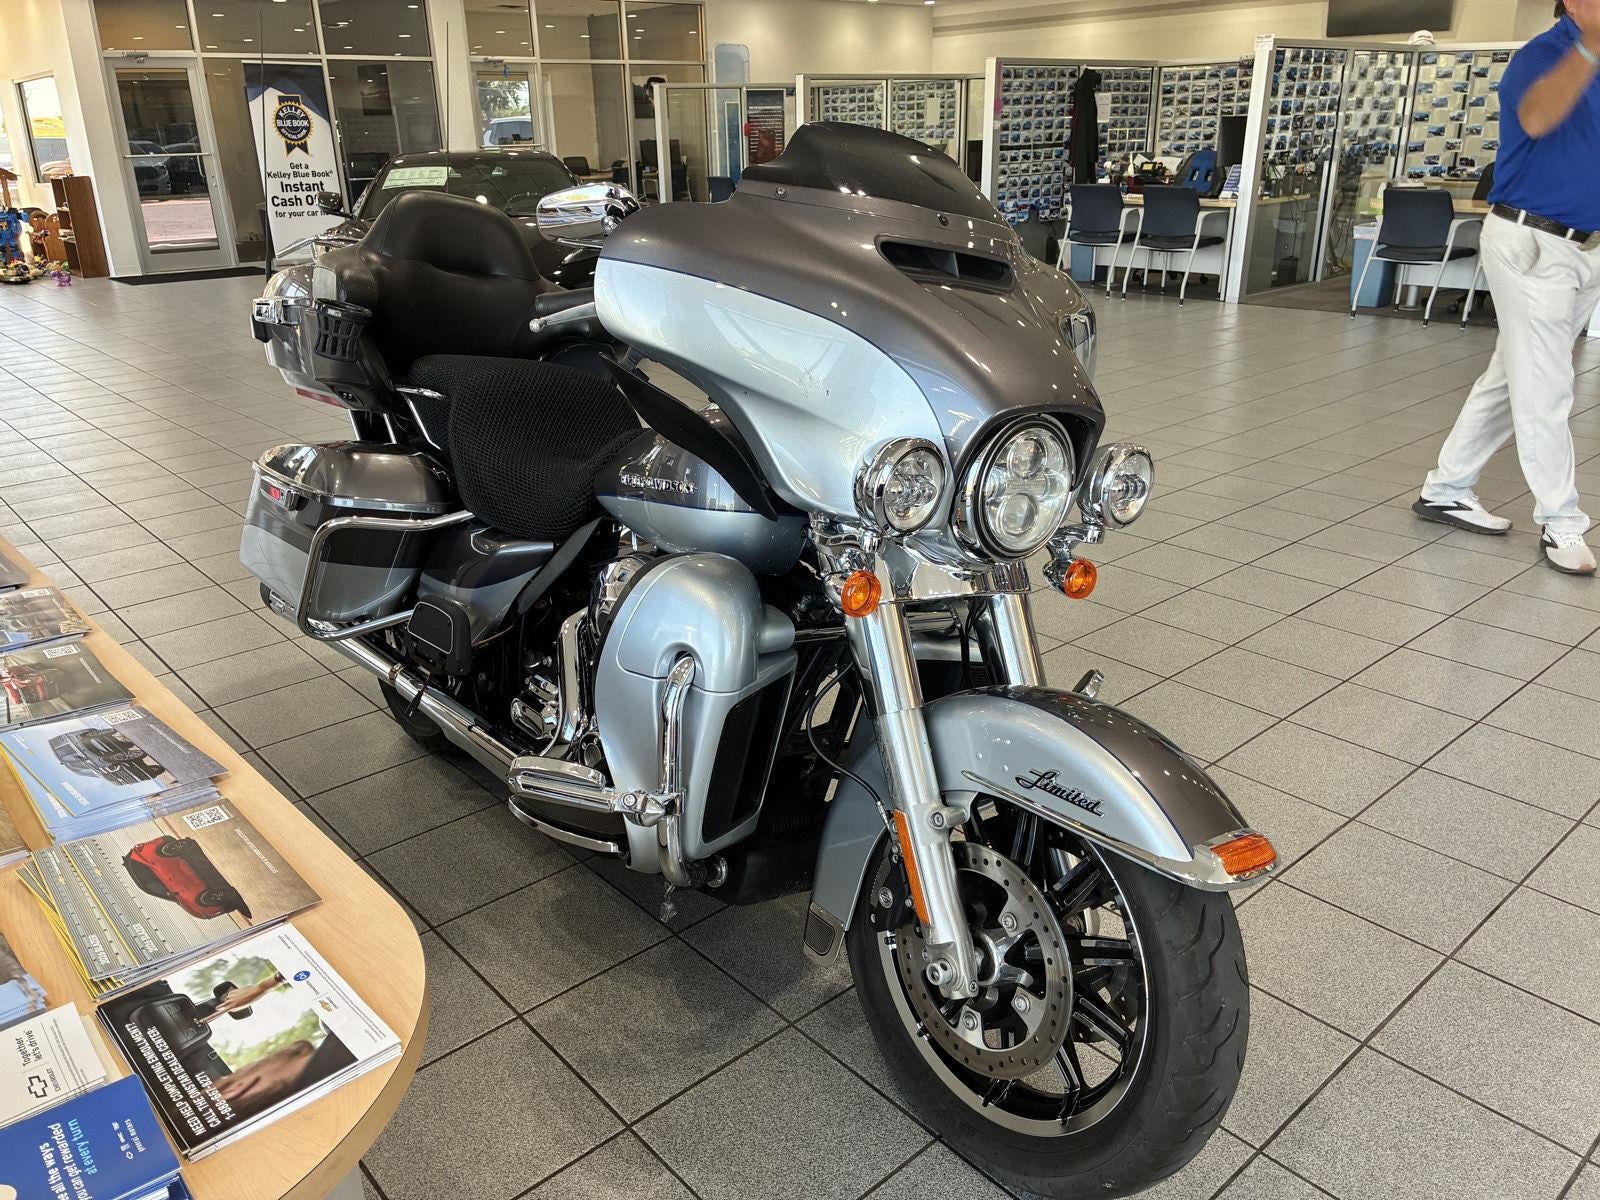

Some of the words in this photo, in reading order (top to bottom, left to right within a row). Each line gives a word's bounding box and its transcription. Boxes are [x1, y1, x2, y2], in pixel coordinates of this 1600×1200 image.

[279, 106, 305, 117] KELLEY
[276, 119, 292, 127] BLUE
[292, 119, 309, 127] BOOK
[267, 171, 291, 179] Kelley
[293, 170, 310, 178] Blue
[280, 181, 325, 192] Instant
[271, 195, 303, 207] Cash
[275, 210, 286, 218] for
[288, 210, 305, 218] your
[1015, 768, 1104, 818] Limited
[25, 1030, 37, 1047] drive
[125, 1022, 157, 1063] ENROLLMENT?
[16, 1037, 31, 1066] Together
[32, 1046, 42, 1061] let's
[162, 1050, 184, 1075] DEALER
[47, 1068, 60, 1091] CHEVROLET
[151, 1061, 183, 1101] COMPLETING
[177, 1073, 200, 1098] ONSTAR
[194, 1096, 209, 1111] THE
[195, 1071, 235, 1120] 1-888-667-8271
[176, 1100, 194, 1118] HELP
[187, 1116, 206, 1135] NEED
[202, 1108, 221, 1128] CALL
[68, 1118, 84, 1141] turn
[48, 1122, 73, 1164] rewarded
[40, 1142, 57, 1168] ways
[77, 1140, 94, 1166] every
[47, 1167, 62, 1184] the
[62, 1163, 82, 1178] get
[84, 1164, 97, 1175] at
[51, 1182, 65, 1194] all
[70, 1176, 84, 1189] can
[75, 1187, 92, 1200] you
